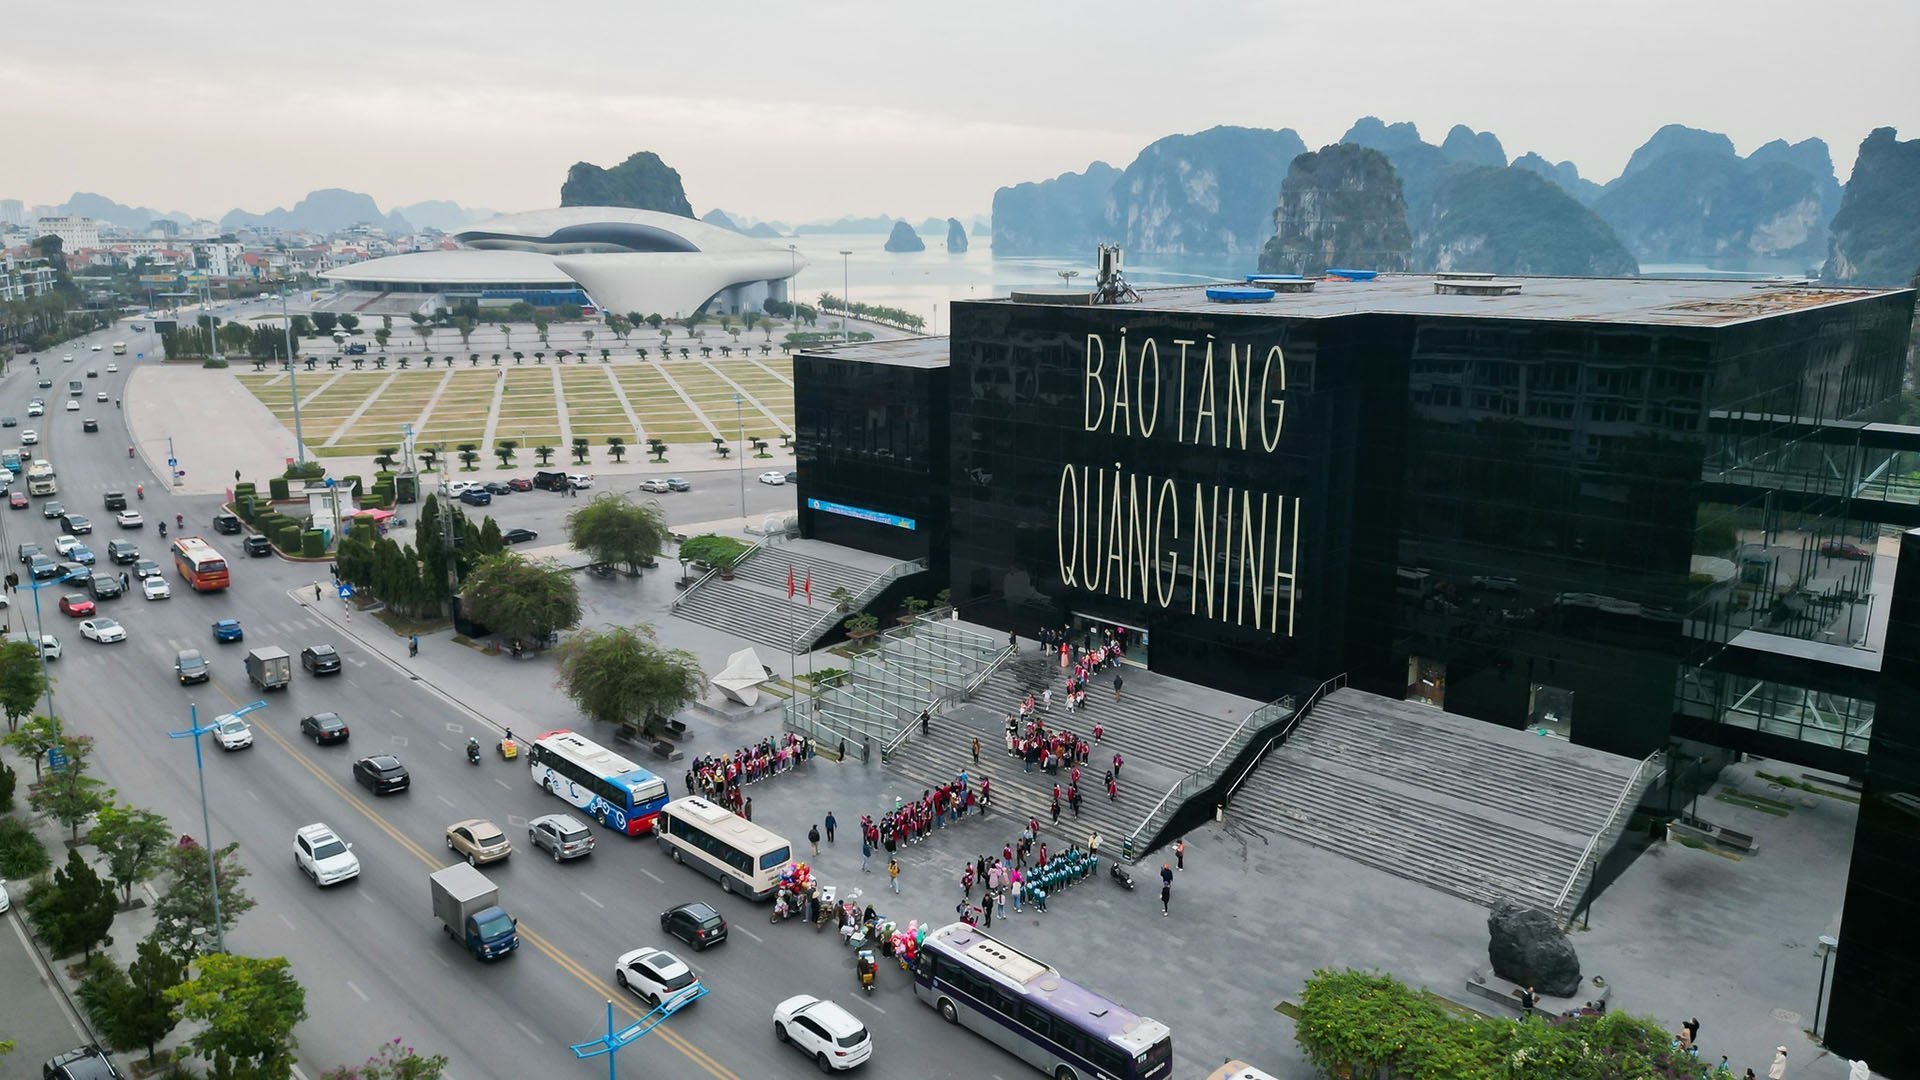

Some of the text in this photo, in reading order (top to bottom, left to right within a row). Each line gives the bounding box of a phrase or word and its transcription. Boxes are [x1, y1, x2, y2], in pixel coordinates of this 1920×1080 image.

[1085, 326, 1286, 453] BẢO TÀNG
[1058, 462, 1300, 637] QUẢNG NINH
